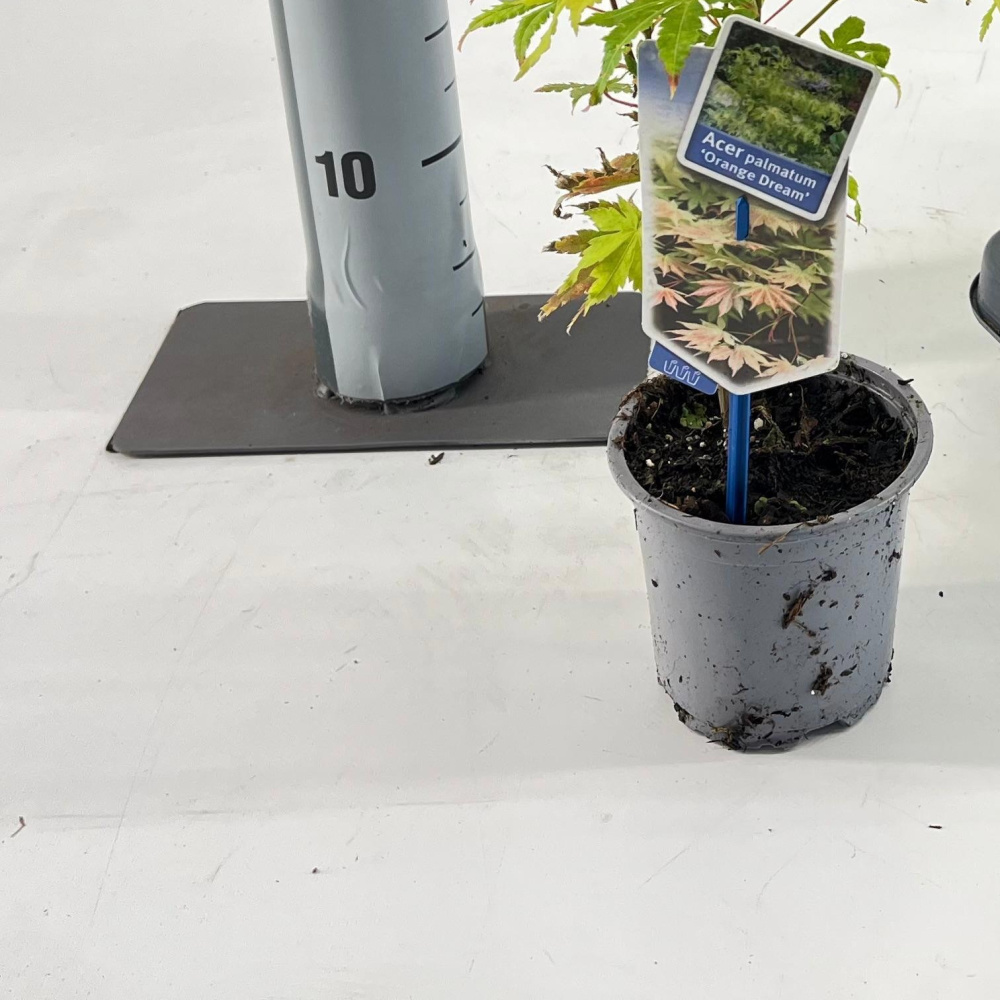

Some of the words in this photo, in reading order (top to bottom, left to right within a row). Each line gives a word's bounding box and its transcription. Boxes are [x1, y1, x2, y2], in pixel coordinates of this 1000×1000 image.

[315, 151, 377, 200] 10
[702, 131, 745, 159] Acer
[744, 153, 818, 189] palmatum
